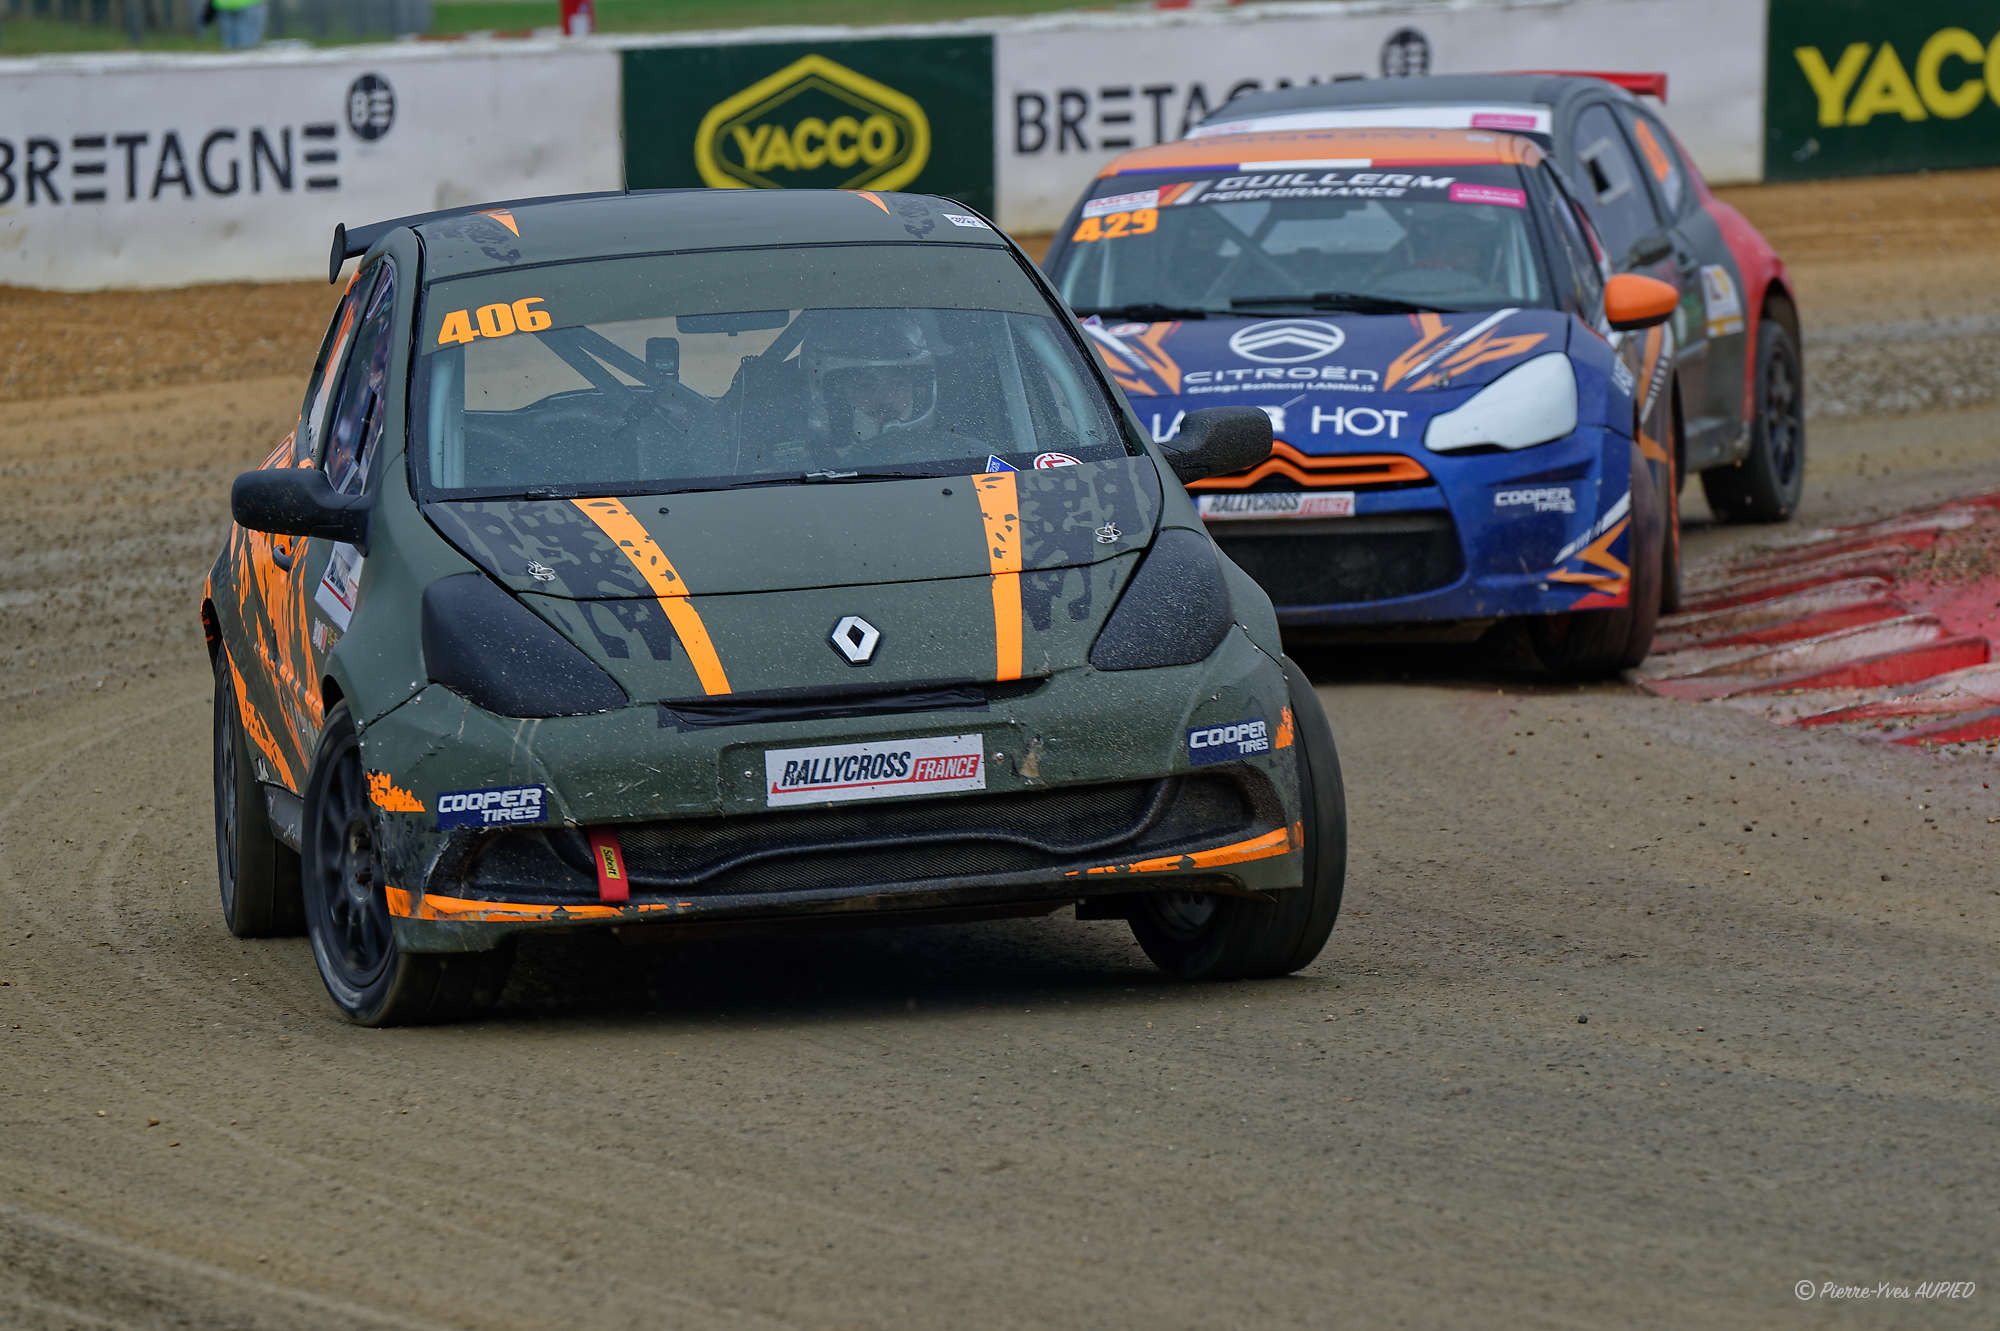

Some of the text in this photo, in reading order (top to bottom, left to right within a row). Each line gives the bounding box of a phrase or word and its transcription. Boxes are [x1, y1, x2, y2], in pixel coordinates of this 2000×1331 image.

[1793, 26, 2000, 129] YAC
[1014, 72, 1366, 153] BRETA
[731, 114, 898, 172] YACCO
[1200, 186, 1406, 202] PERFORMANCE
[1215, 172, 1456, 190] GUILLERM
[1072, 209, 1159, 243] 429
[437, 296, 552, 345] 406
[1311, 405, 1408, 439] HOT
[1494, 487, 1571, 506] COOPER
[1189, 721, 1267, 749] COOPER
[1237, 737, 1269, 754] TIRES
[781, 751, 977, 787] RALLYCROSS FRANCE
[438, 788, 542, 813] COOPER
[480, 805, 541, 822] TIRES
